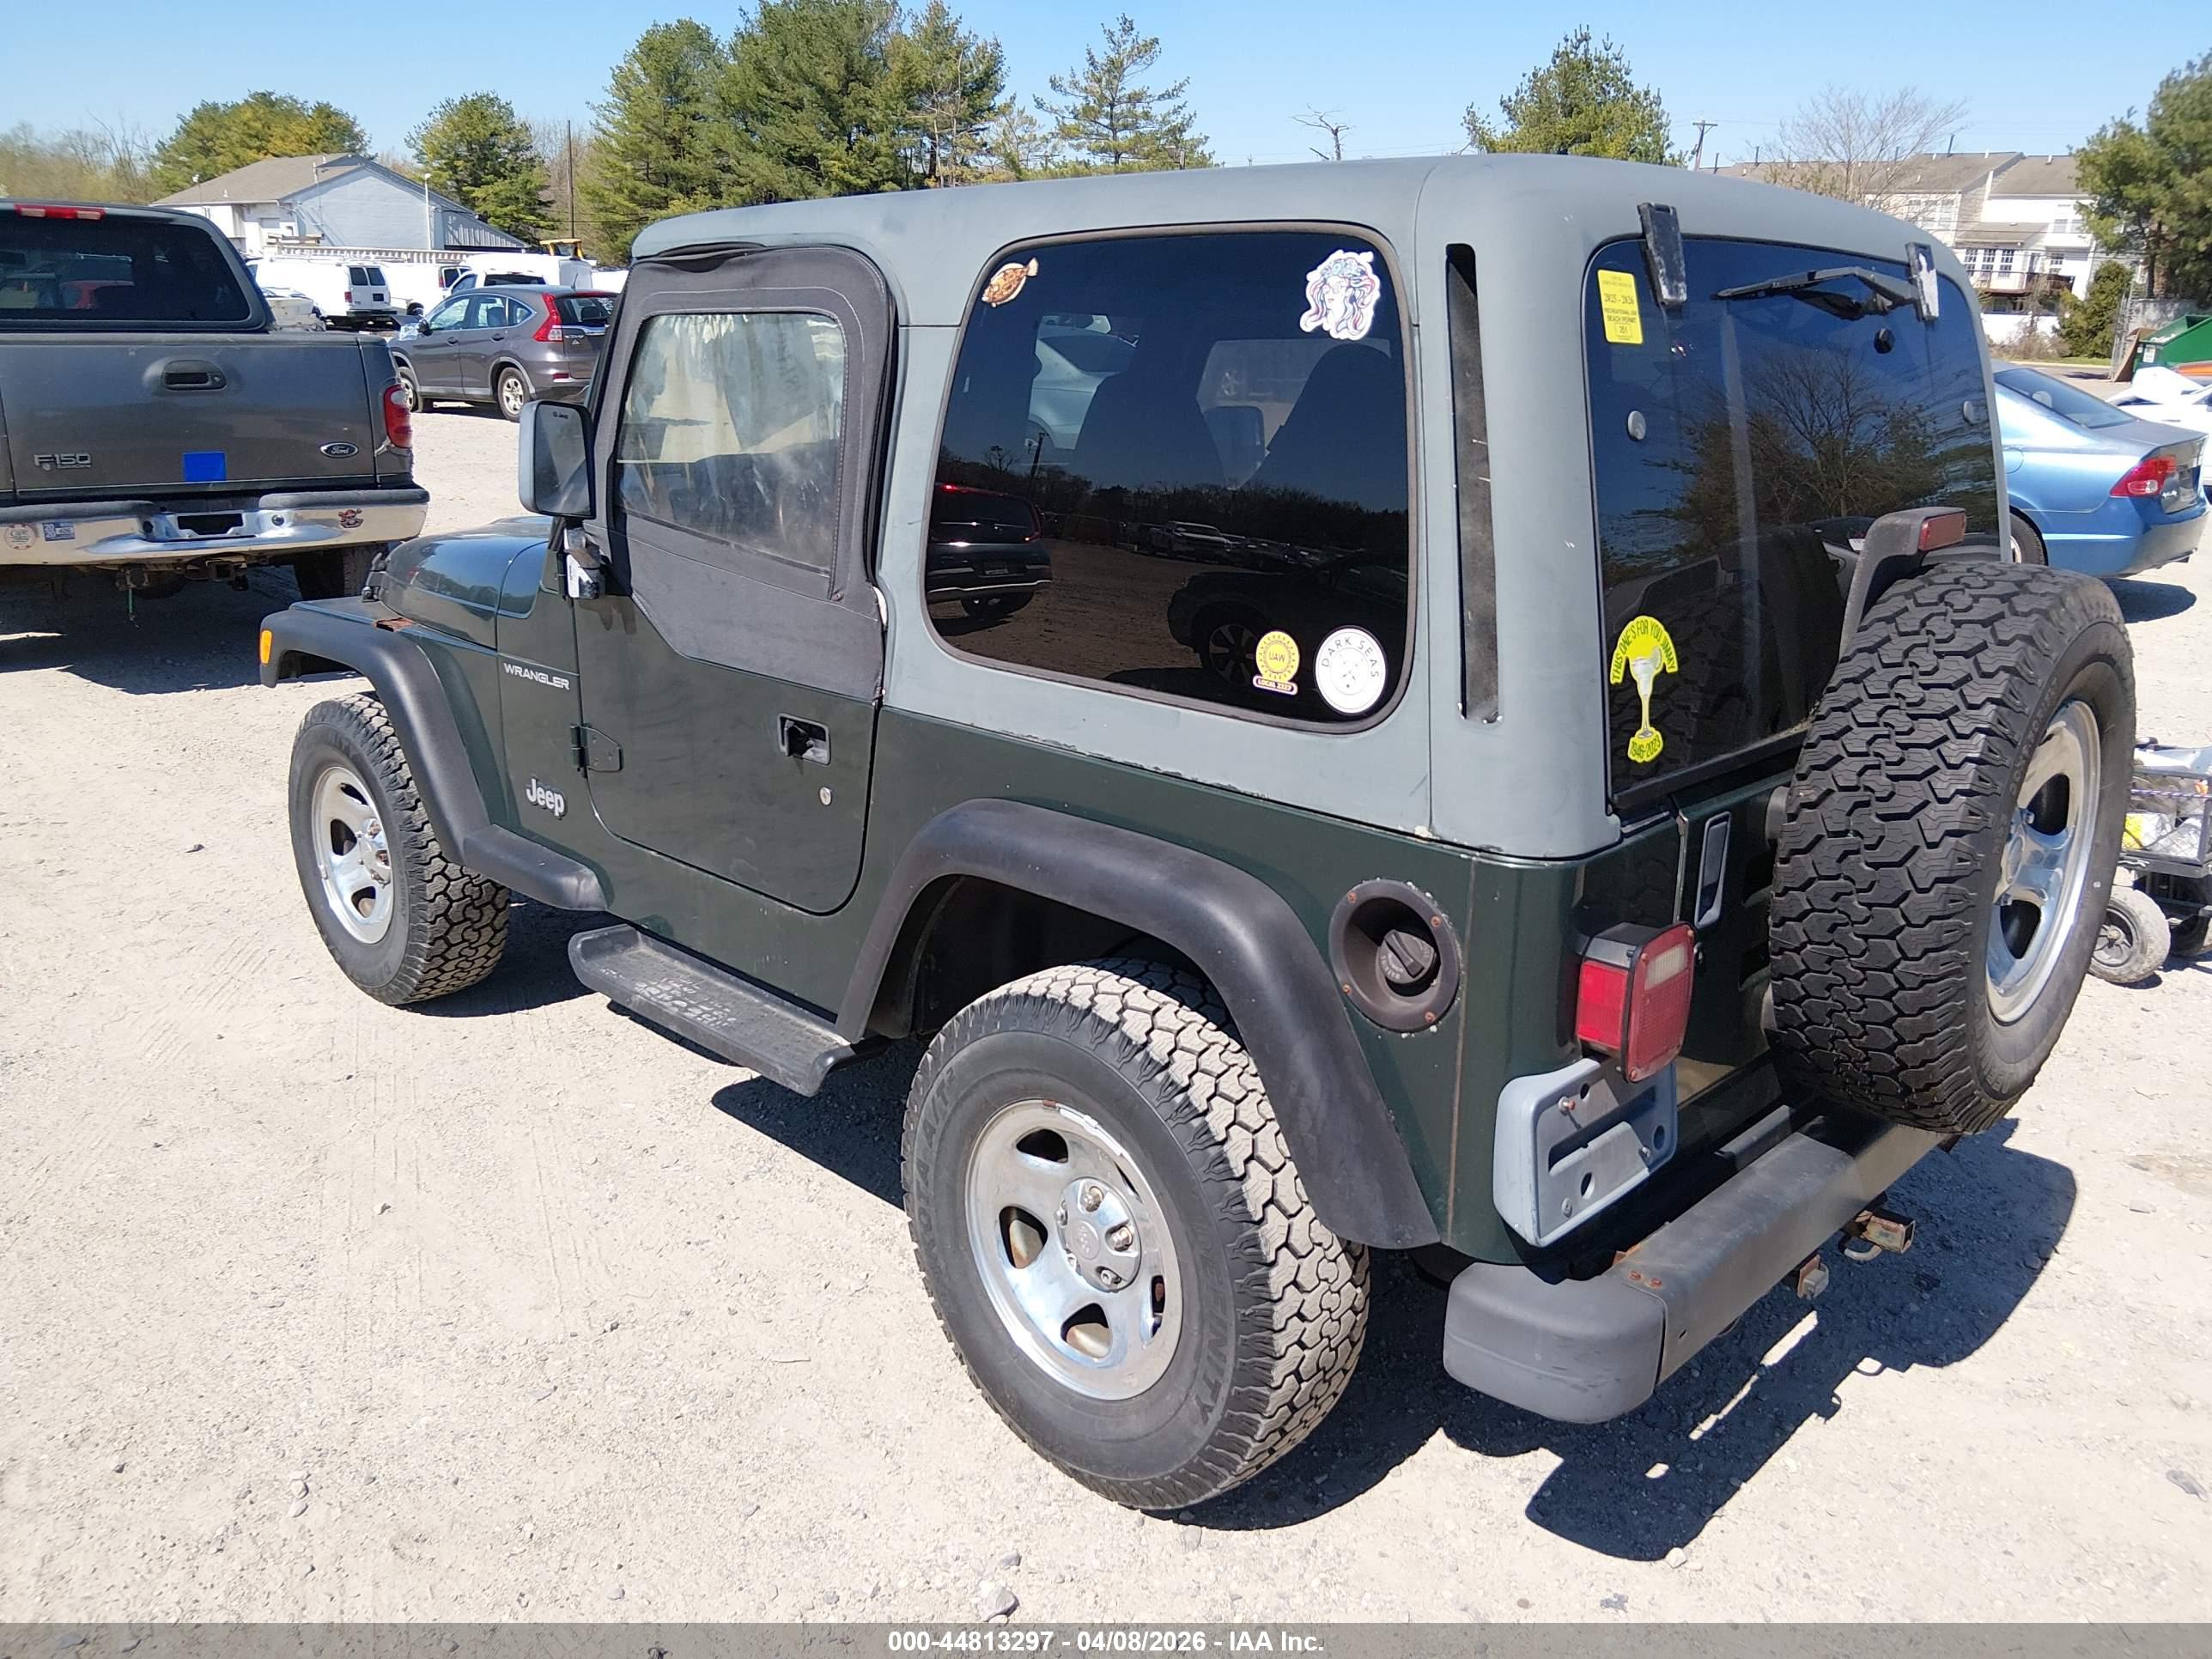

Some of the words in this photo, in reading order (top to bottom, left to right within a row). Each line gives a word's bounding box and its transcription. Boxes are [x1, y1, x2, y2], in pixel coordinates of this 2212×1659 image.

[331, 446, 349, 454] Ford
[1268, 652, 1285, 664] UAW
[1322, 637, 1352, 667] DARK
[1357, 640, 1380, 678] SEAS
[1612, 653, 1624, 681] THIS
[1620, 625, 1637, 654] ONE'S
[1636, 619, 1649, 636] FOR
[1660, 636, 1675, 670] JIMMY
[503, 663, 570, 690] WRANGLER
[1257, 678, 1277, 689] LOCAL
[526, 778, 565, 817] Jeep
